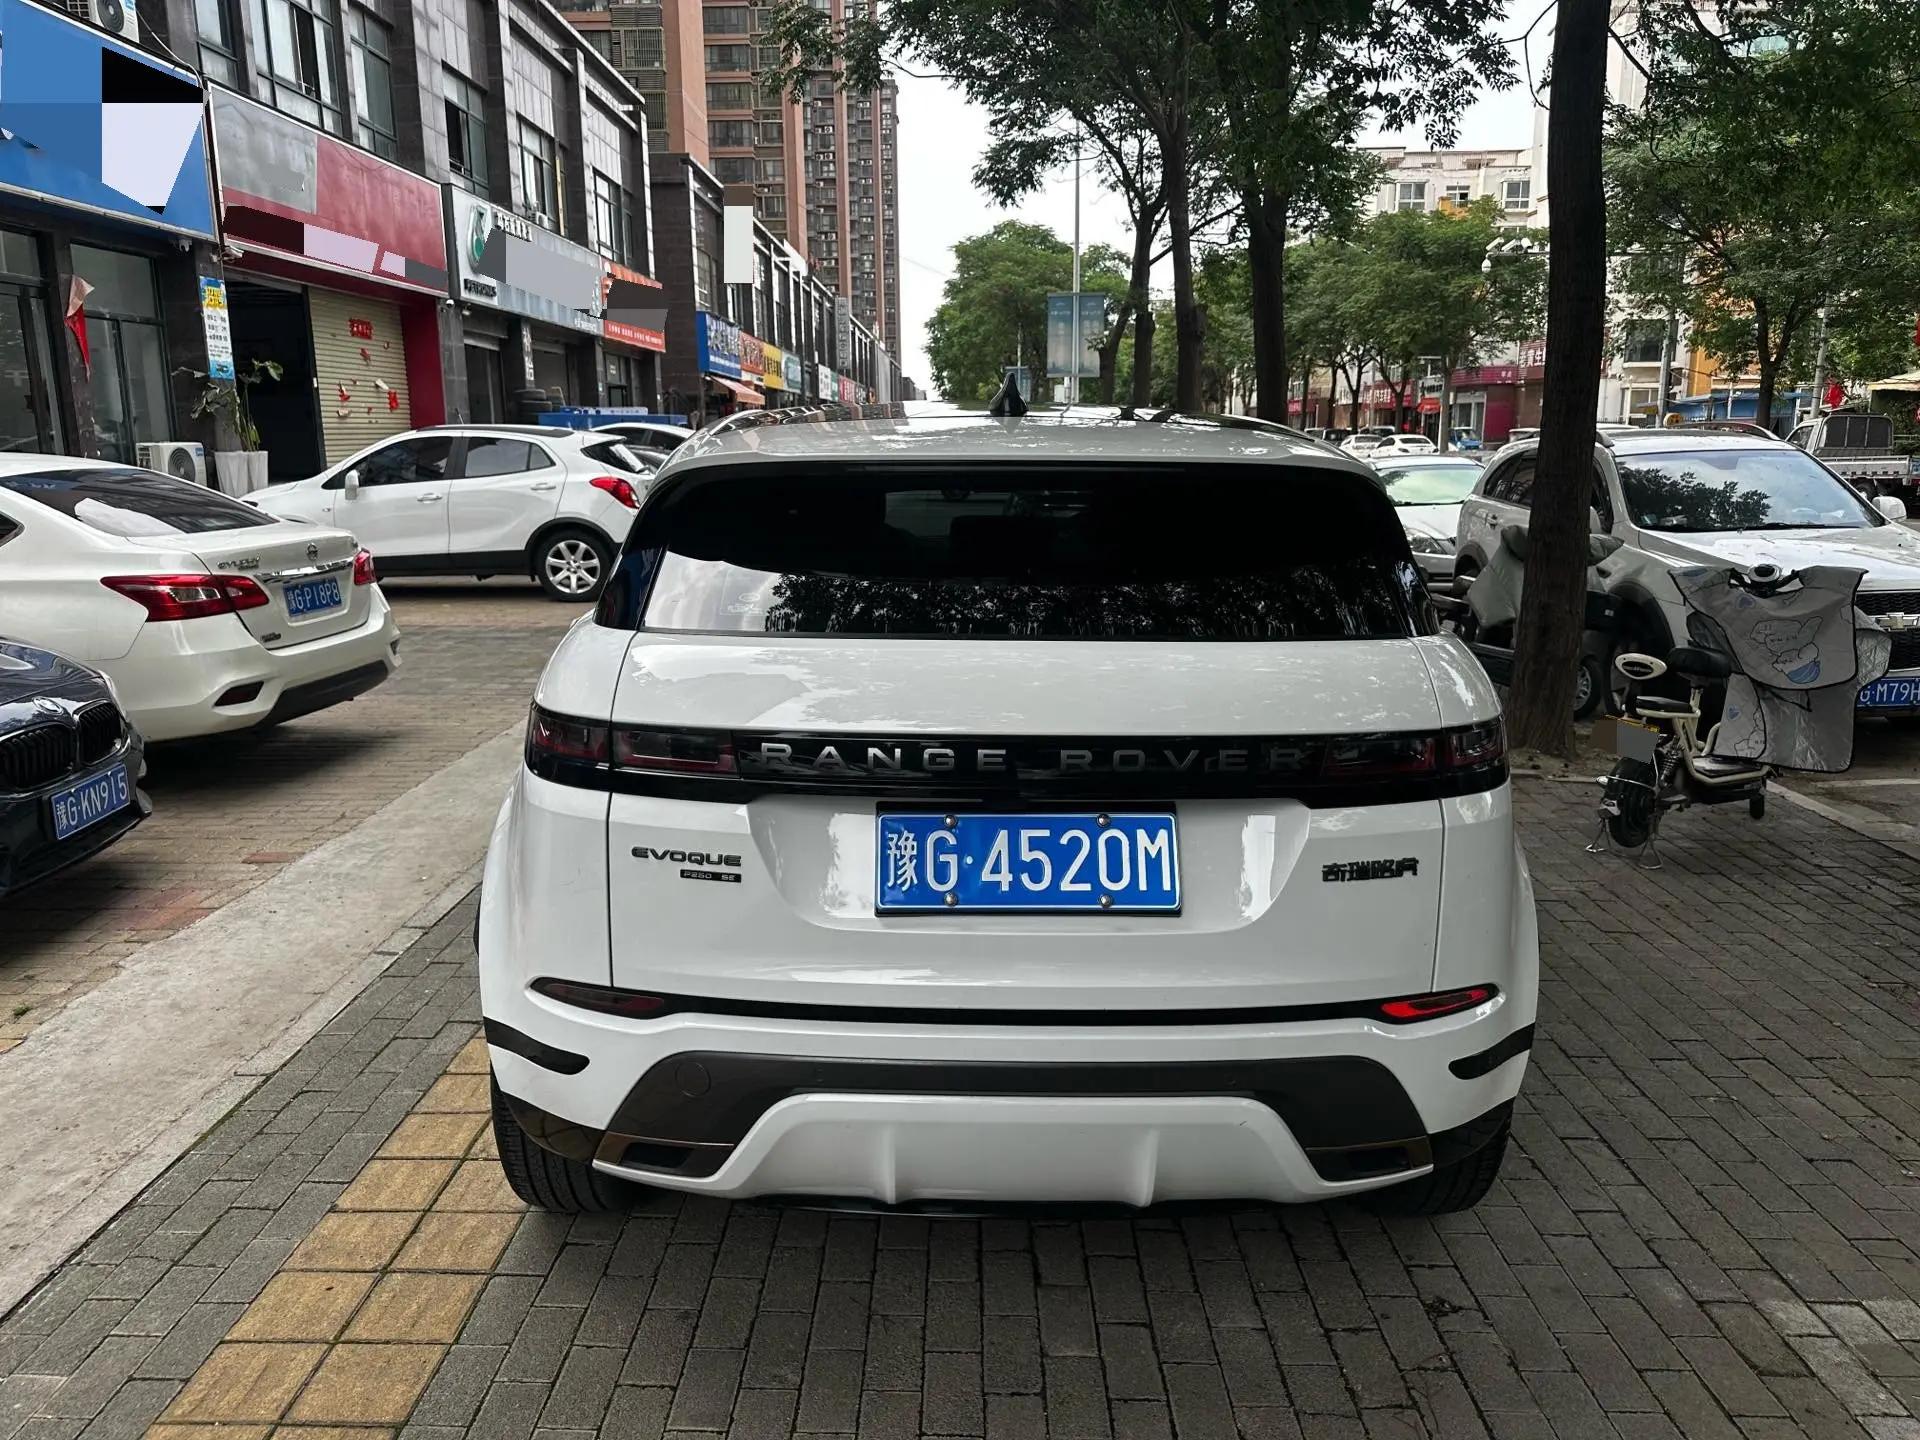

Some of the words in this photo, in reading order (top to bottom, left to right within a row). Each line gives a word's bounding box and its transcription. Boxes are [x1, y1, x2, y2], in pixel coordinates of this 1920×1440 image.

[760, 742, 1008, 772] RANGE
[1060, 748, 1307, 773] ROVER
[631, 846, 742, 867] EVOQUE
[887, 828, 1172, 892] 豫G·4520M
[683, 870, 713, 879] P250
[721, 873, 736, 881] SE
